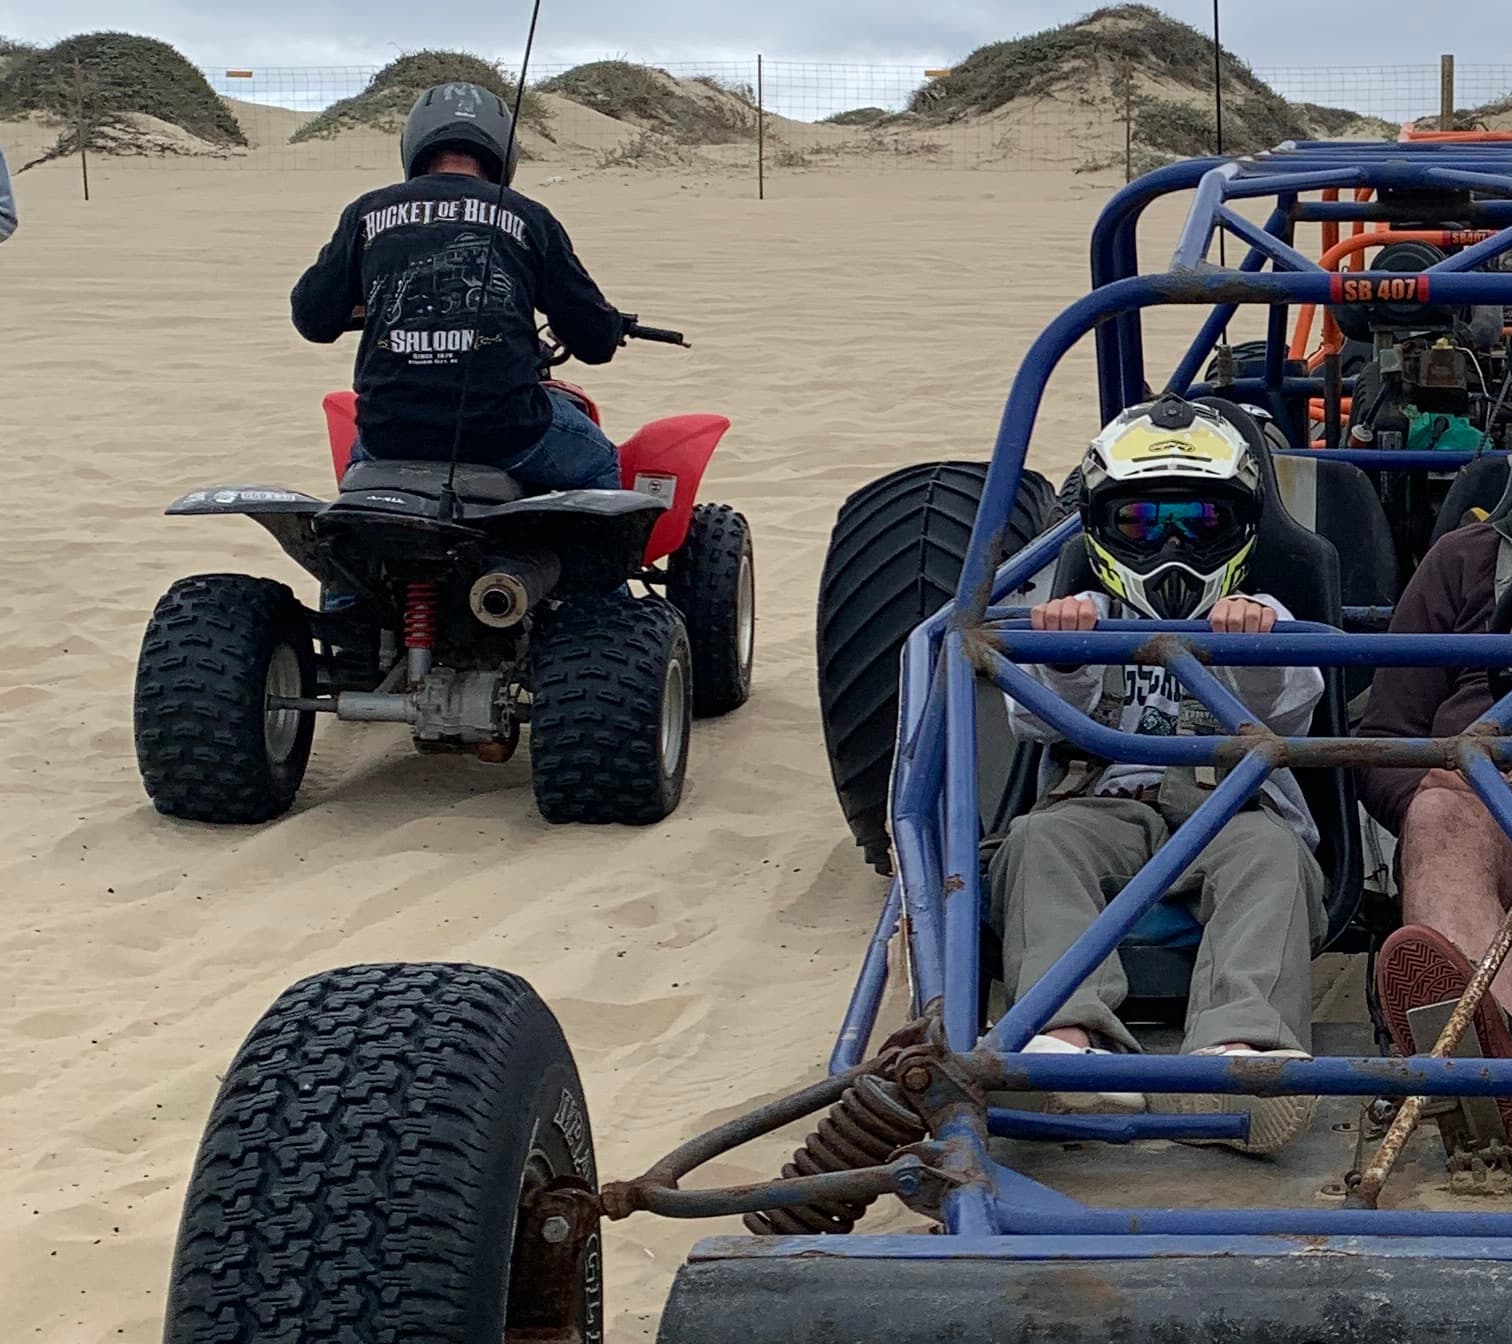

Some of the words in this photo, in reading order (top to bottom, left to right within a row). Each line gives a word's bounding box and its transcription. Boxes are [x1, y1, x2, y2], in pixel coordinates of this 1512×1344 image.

[362, 201, 433, 241] BUCKET
[437, 200, 459, 218] OF
[463, 197, 527, 242] BLOOD
[1343, 279, 1373, 301] SB
[1377, 278, 1417, 301] 407
[390, 329, 475, 354] SALOON
